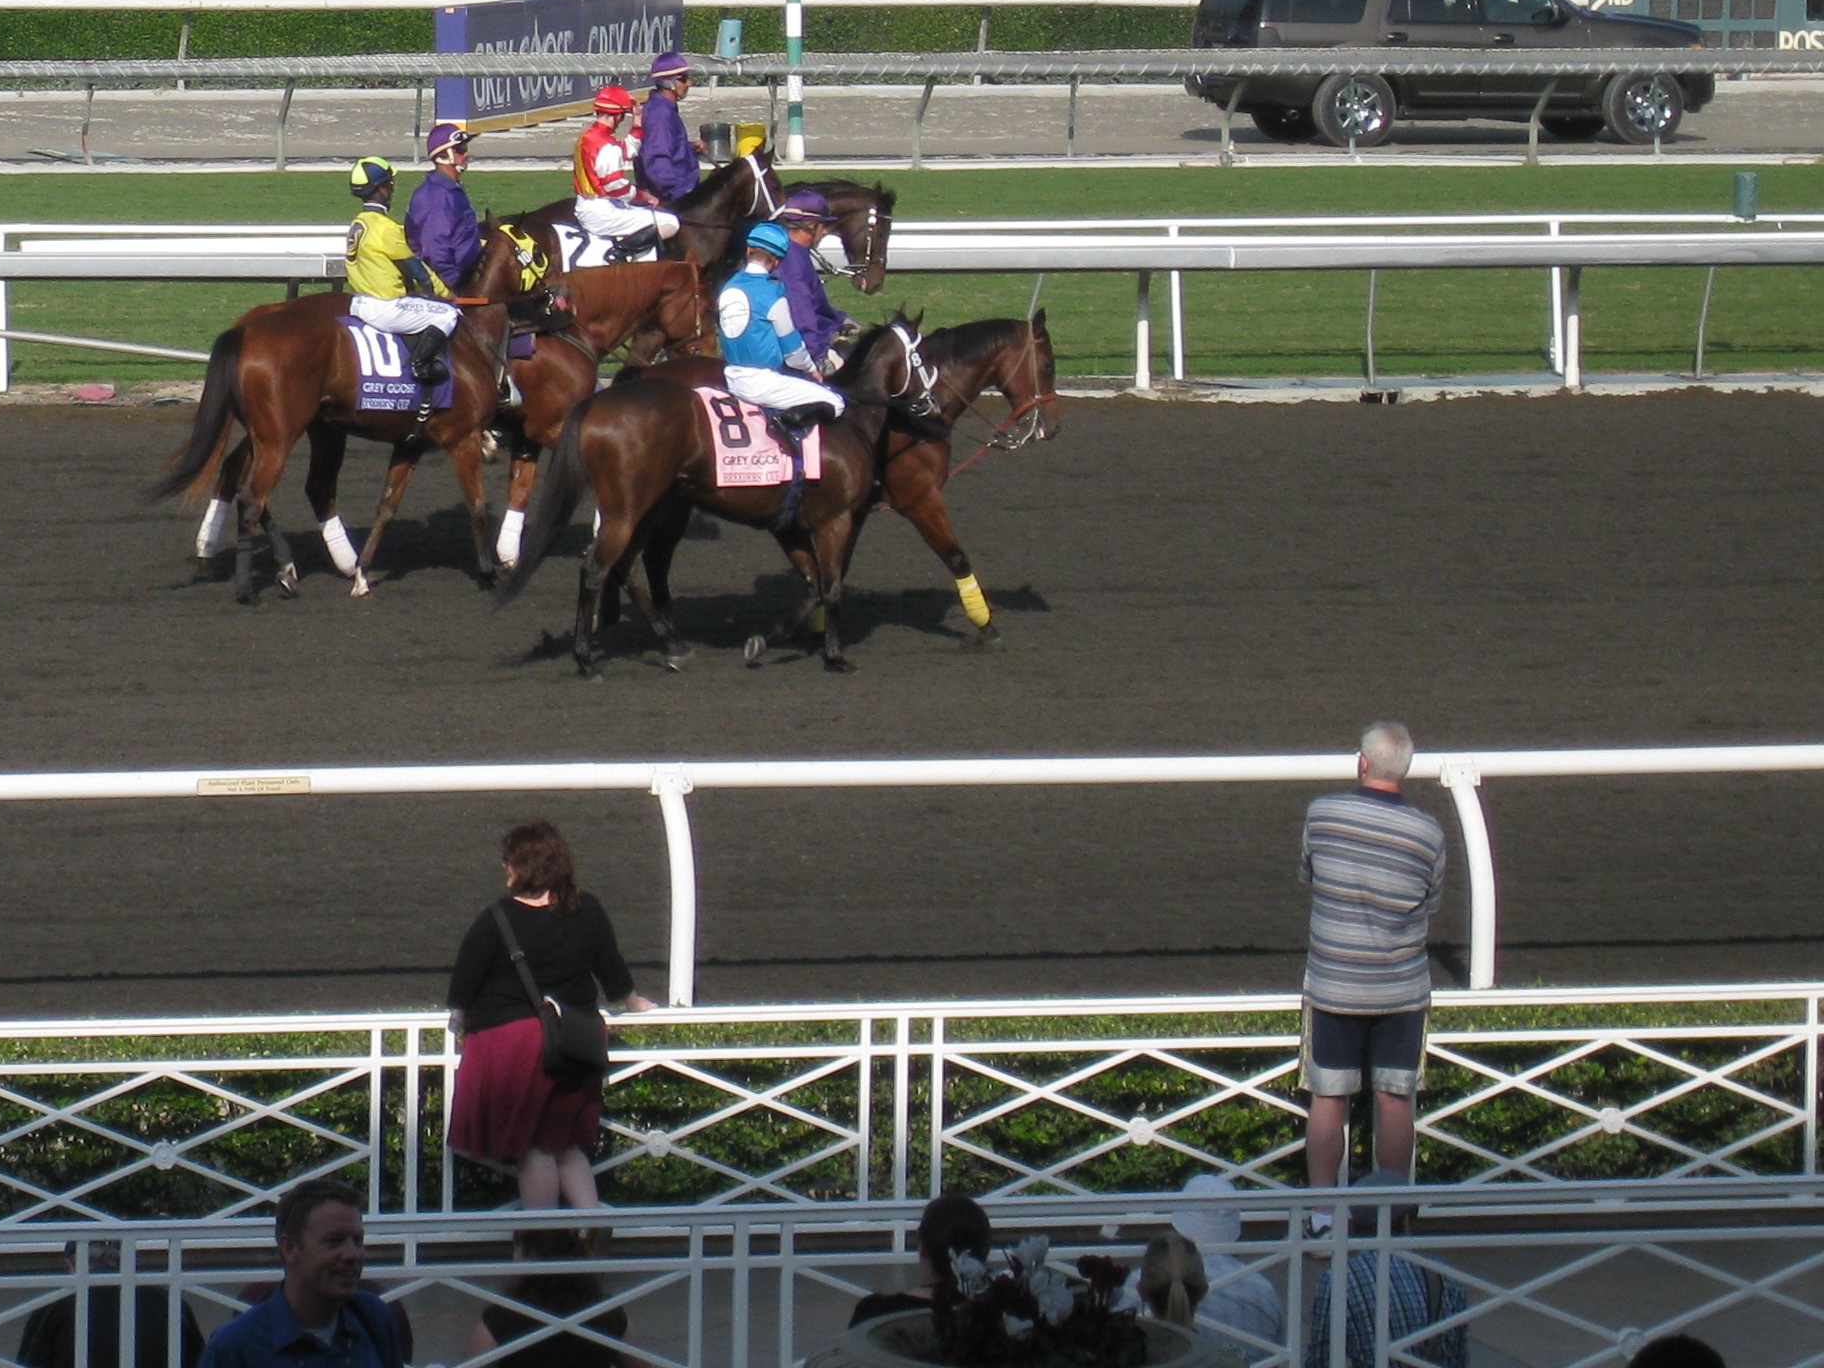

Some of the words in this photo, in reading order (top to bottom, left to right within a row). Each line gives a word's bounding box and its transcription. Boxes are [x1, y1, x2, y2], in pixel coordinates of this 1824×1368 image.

[516, 249, 534, 268] 10
[565, 231, 590, 273] 7
[347, 324, 403, 378] 10
[911, 351, 922, 367] 8
[362, 382, 386, 394] GREY
[386, 382, 417, 394] GOOSE
[709, 395, 753, 449] 8
[722, 455, 749, 466] GREY
[750, 454, 780, 466] GOOS
